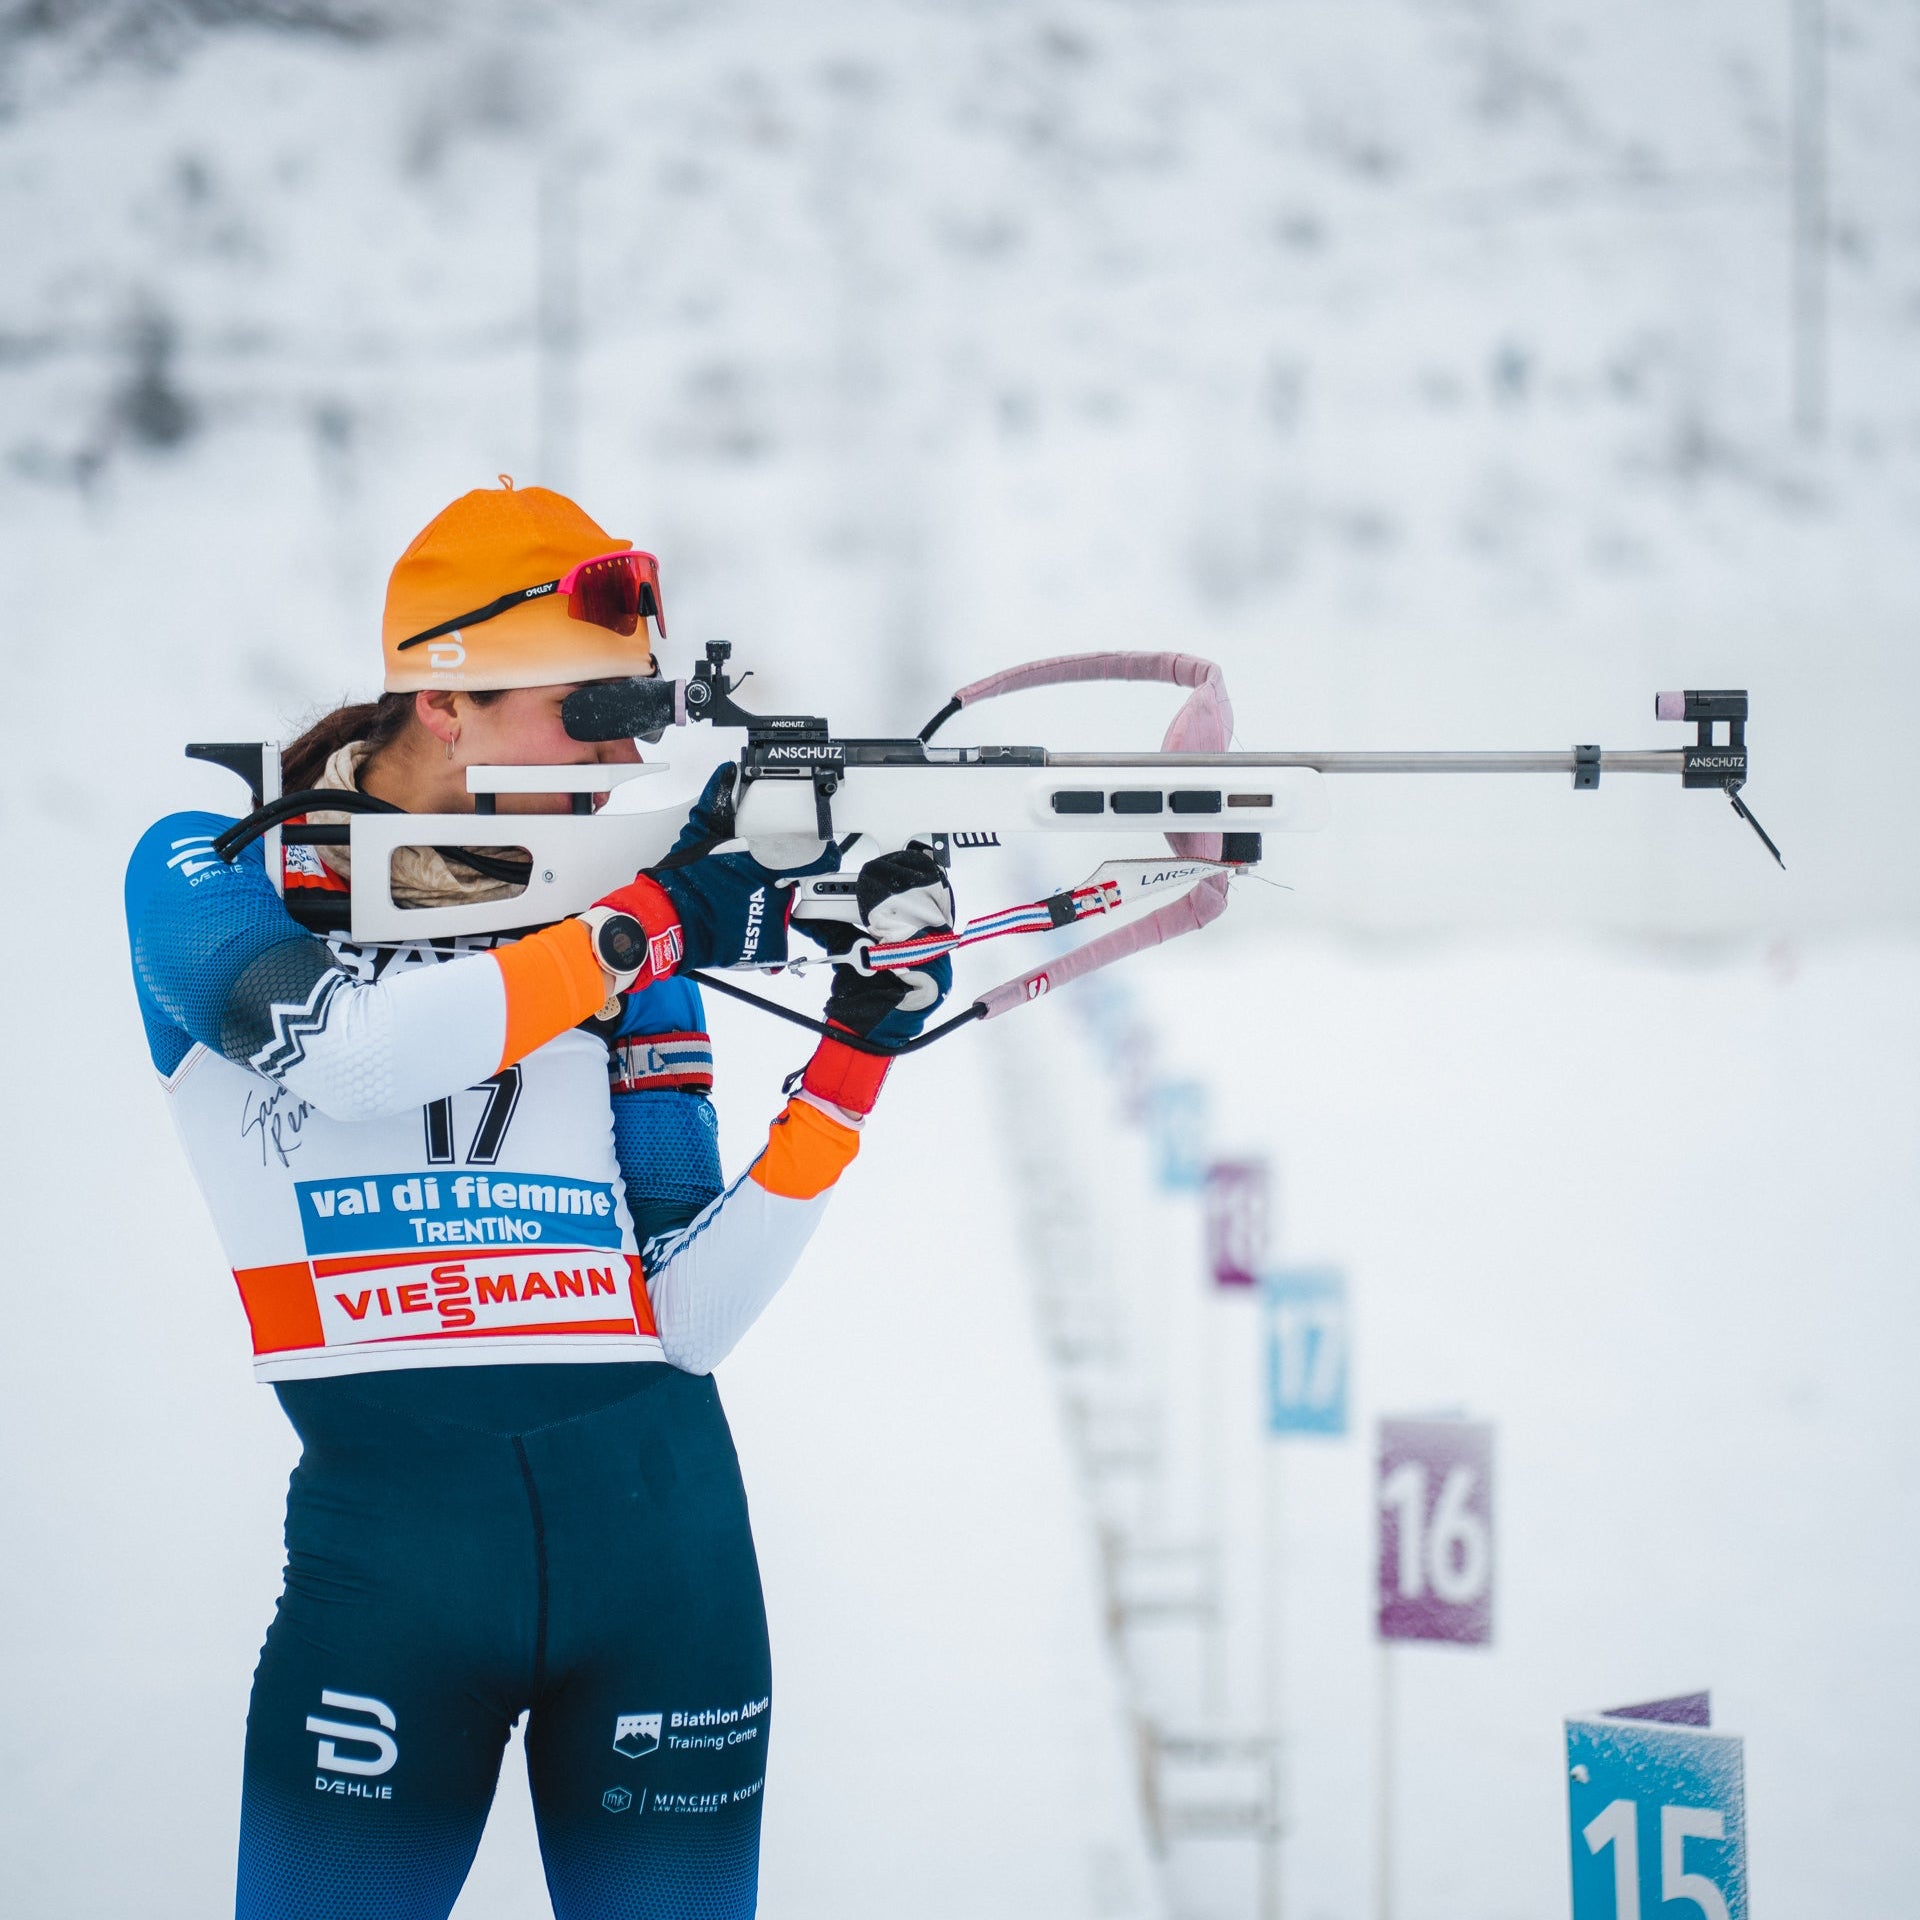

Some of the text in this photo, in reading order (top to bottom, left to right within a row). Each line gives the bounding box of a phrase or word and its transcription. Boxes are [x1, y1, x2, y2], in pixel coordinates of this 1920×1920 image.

[771, 720, 806, 728] ANSCHUTZ
[767, 746, 843, 760] ANSCHUTZ
[1689, 756, 1745, 768] ANSCHUTZ
[739, 886, 766, 962] HESTRA
[422, 1062, 523, 1166] 17
[310, 1175, 611, 1219] val di fiemme
[408, 1214, 543, 1244] TRENTINO
[334, 1263, 617, 1329] VIESSMANN
[1275, 1300, 1344, 1408] 17
[1384, 1460, 1490, 1602] 16
[670, 1708, 739, 1728] Biathlon
[667, 1726, 758, 1751] Training Centre
[652, 1805, 719, 1814] LAW CHAMBERS
[654, 1793, 728, 1807] MINCHER
[1581, 1798, 1733, 1920] 15
